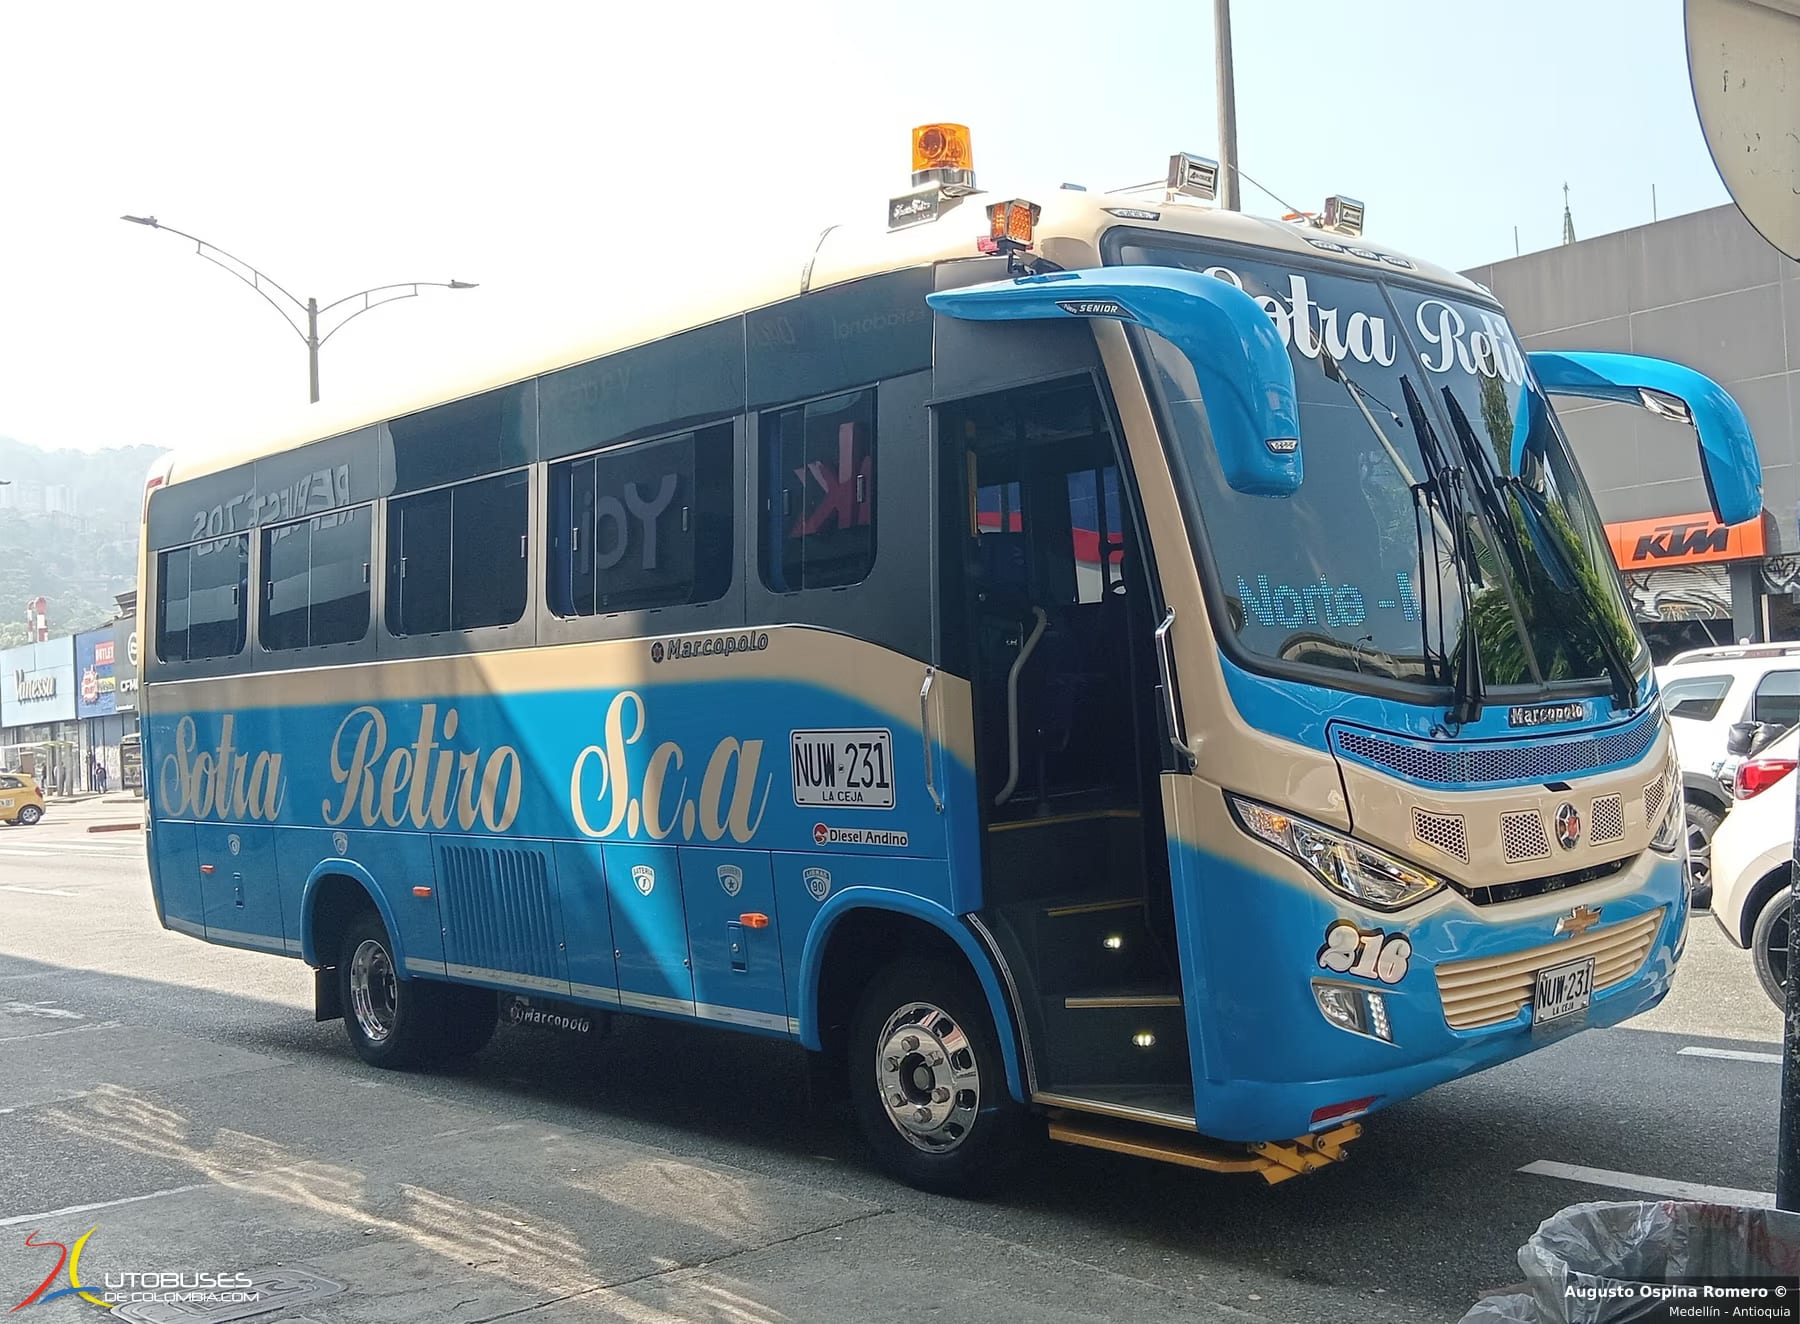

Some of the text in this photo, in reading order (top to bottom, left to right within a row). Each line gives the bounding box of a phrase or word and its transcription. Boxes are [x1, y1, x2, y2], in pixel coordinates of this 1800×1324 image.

[1079, 304, 1118, 313] SENIOR
[1631, 521, 1731, 561] KTM
[667, 630, 769, 660] Marcopolo
[15, 669, 57, 702] Vanessa
[1512, 704, 1583, 724] Marcopolo
[160, 690, 773, 843] Sotra Retiro S.c.a
[822, 791, 864, 803] LA CEJA
[829, 829, 908, 846] Diesel Andino
[812, 880, 824, 892] 90
[524, 1008, 590, 1033] Marcopolo
